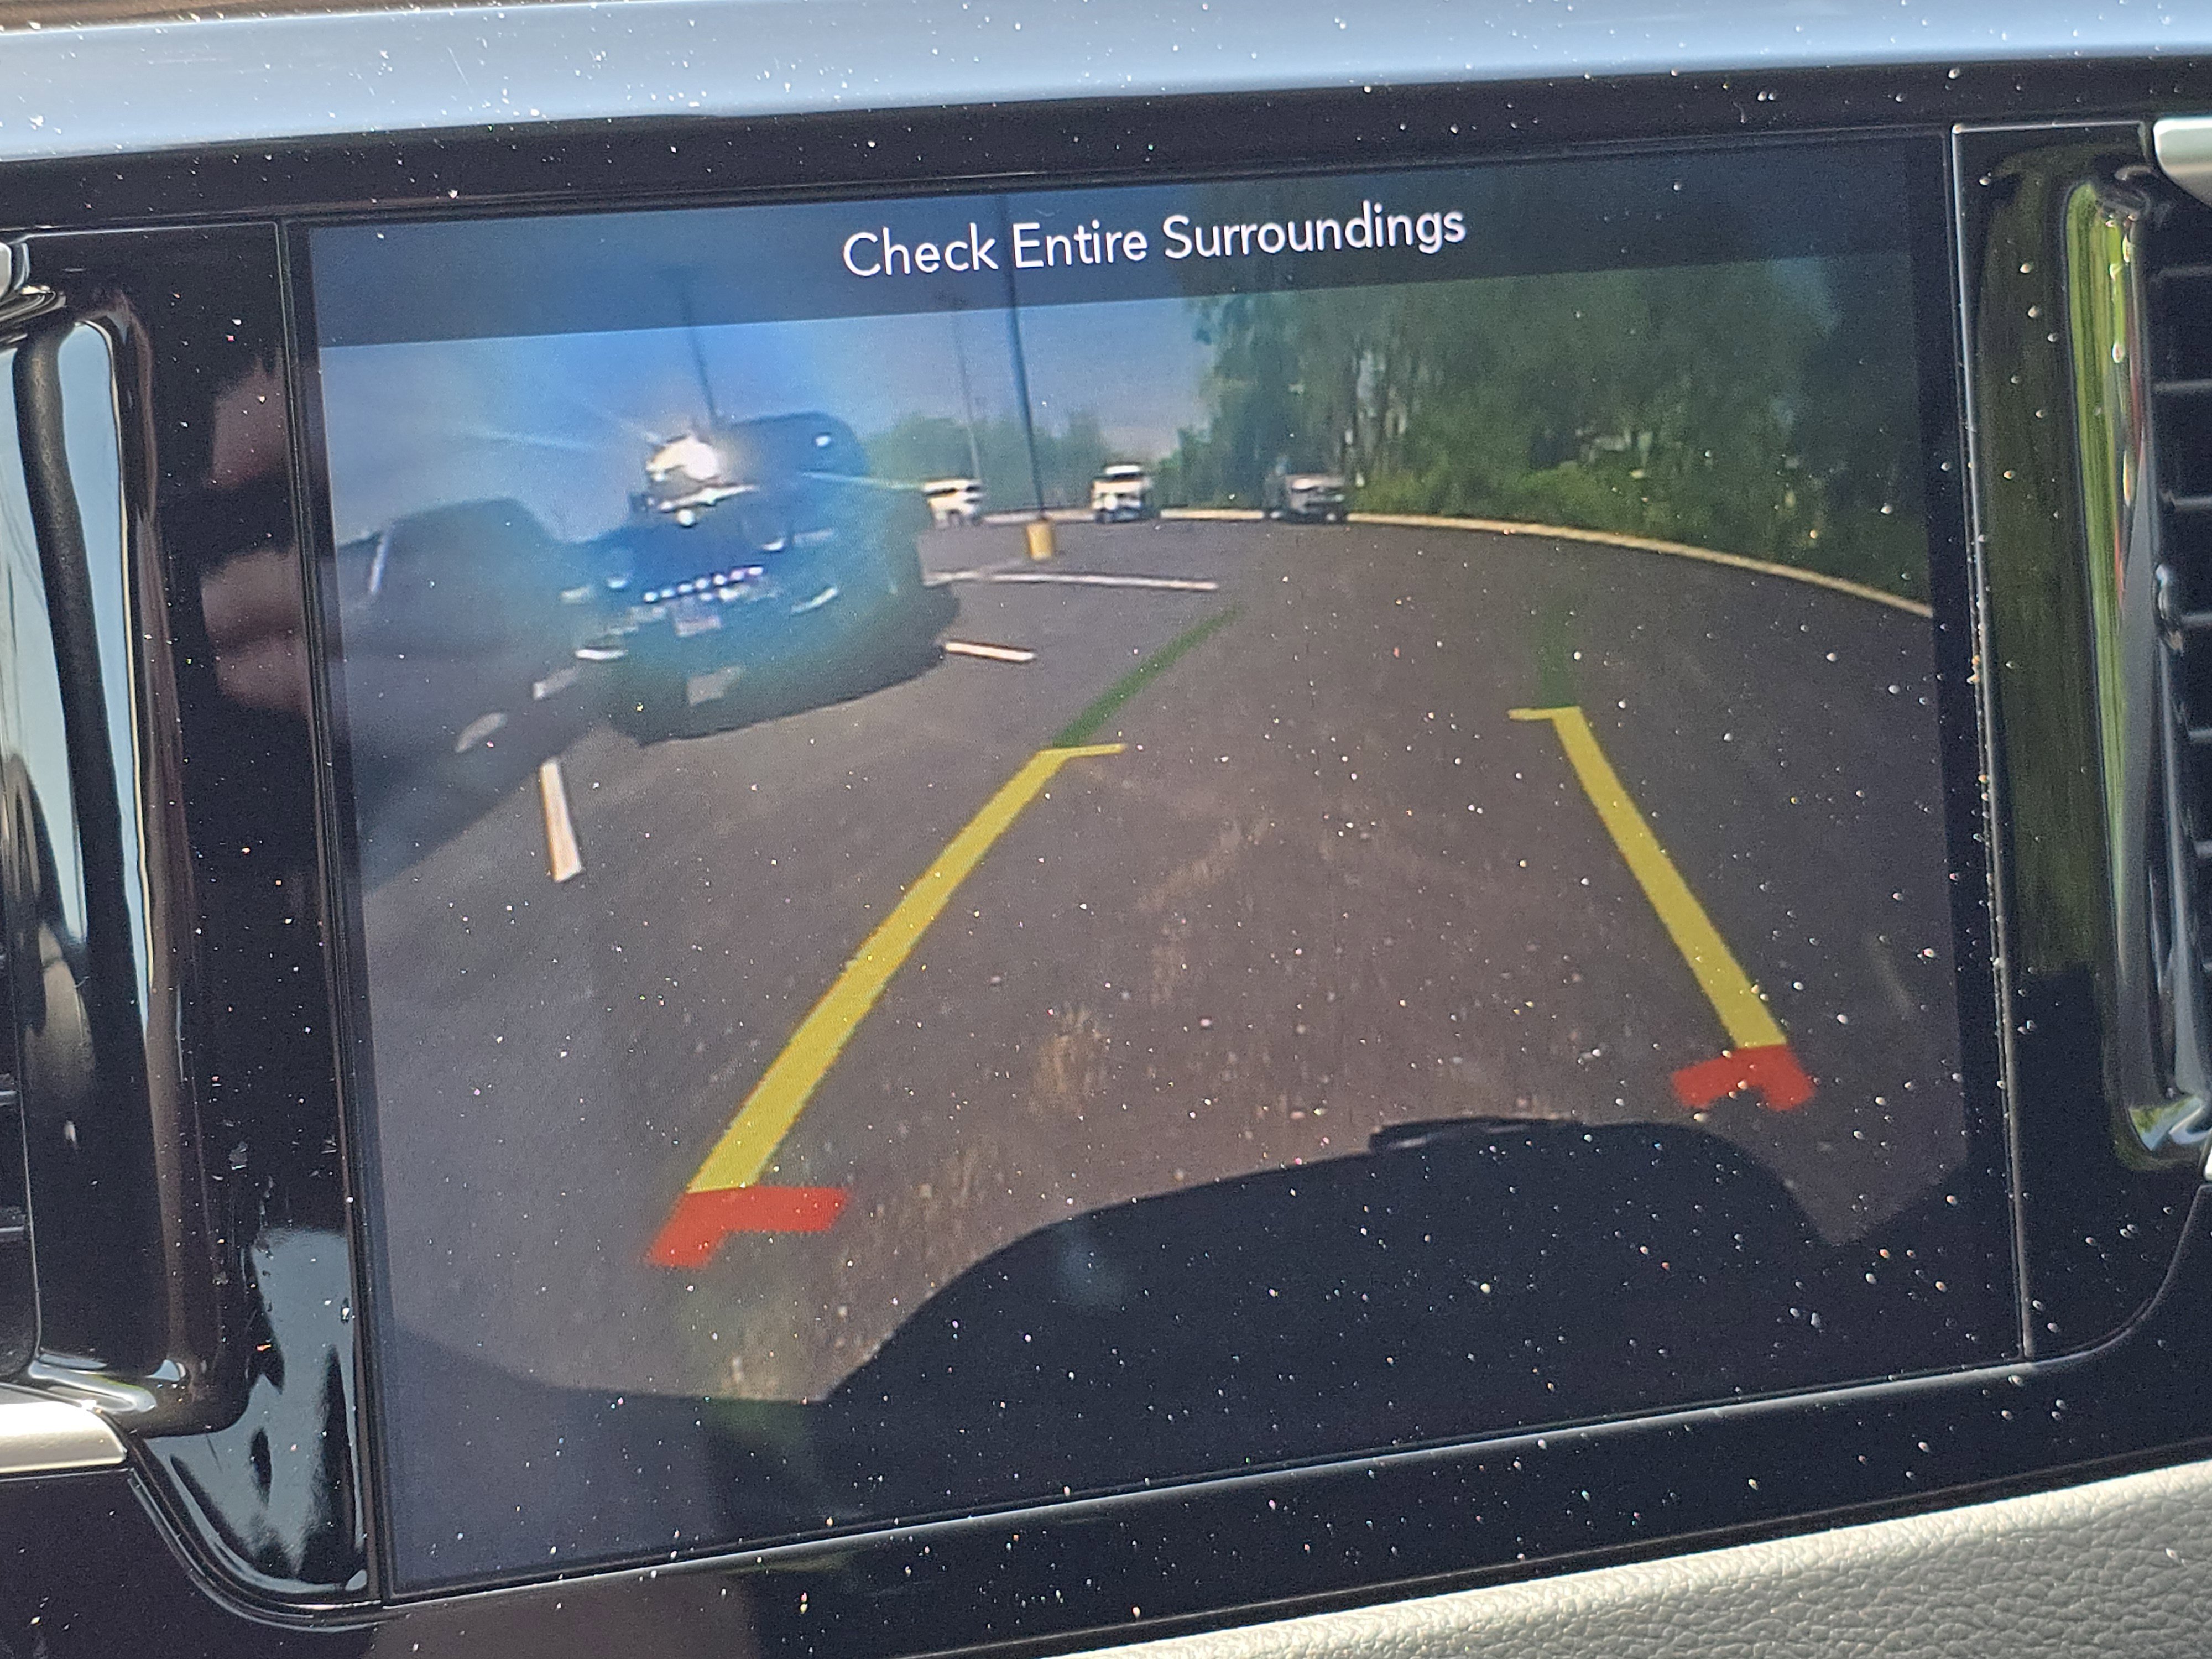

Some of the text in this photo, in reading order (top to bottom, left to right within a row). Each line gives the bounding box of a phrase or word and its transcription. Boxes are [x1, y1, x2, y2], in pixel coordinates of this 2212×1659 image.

[842, 200, 1467, 277] Check Entire Surroundings
